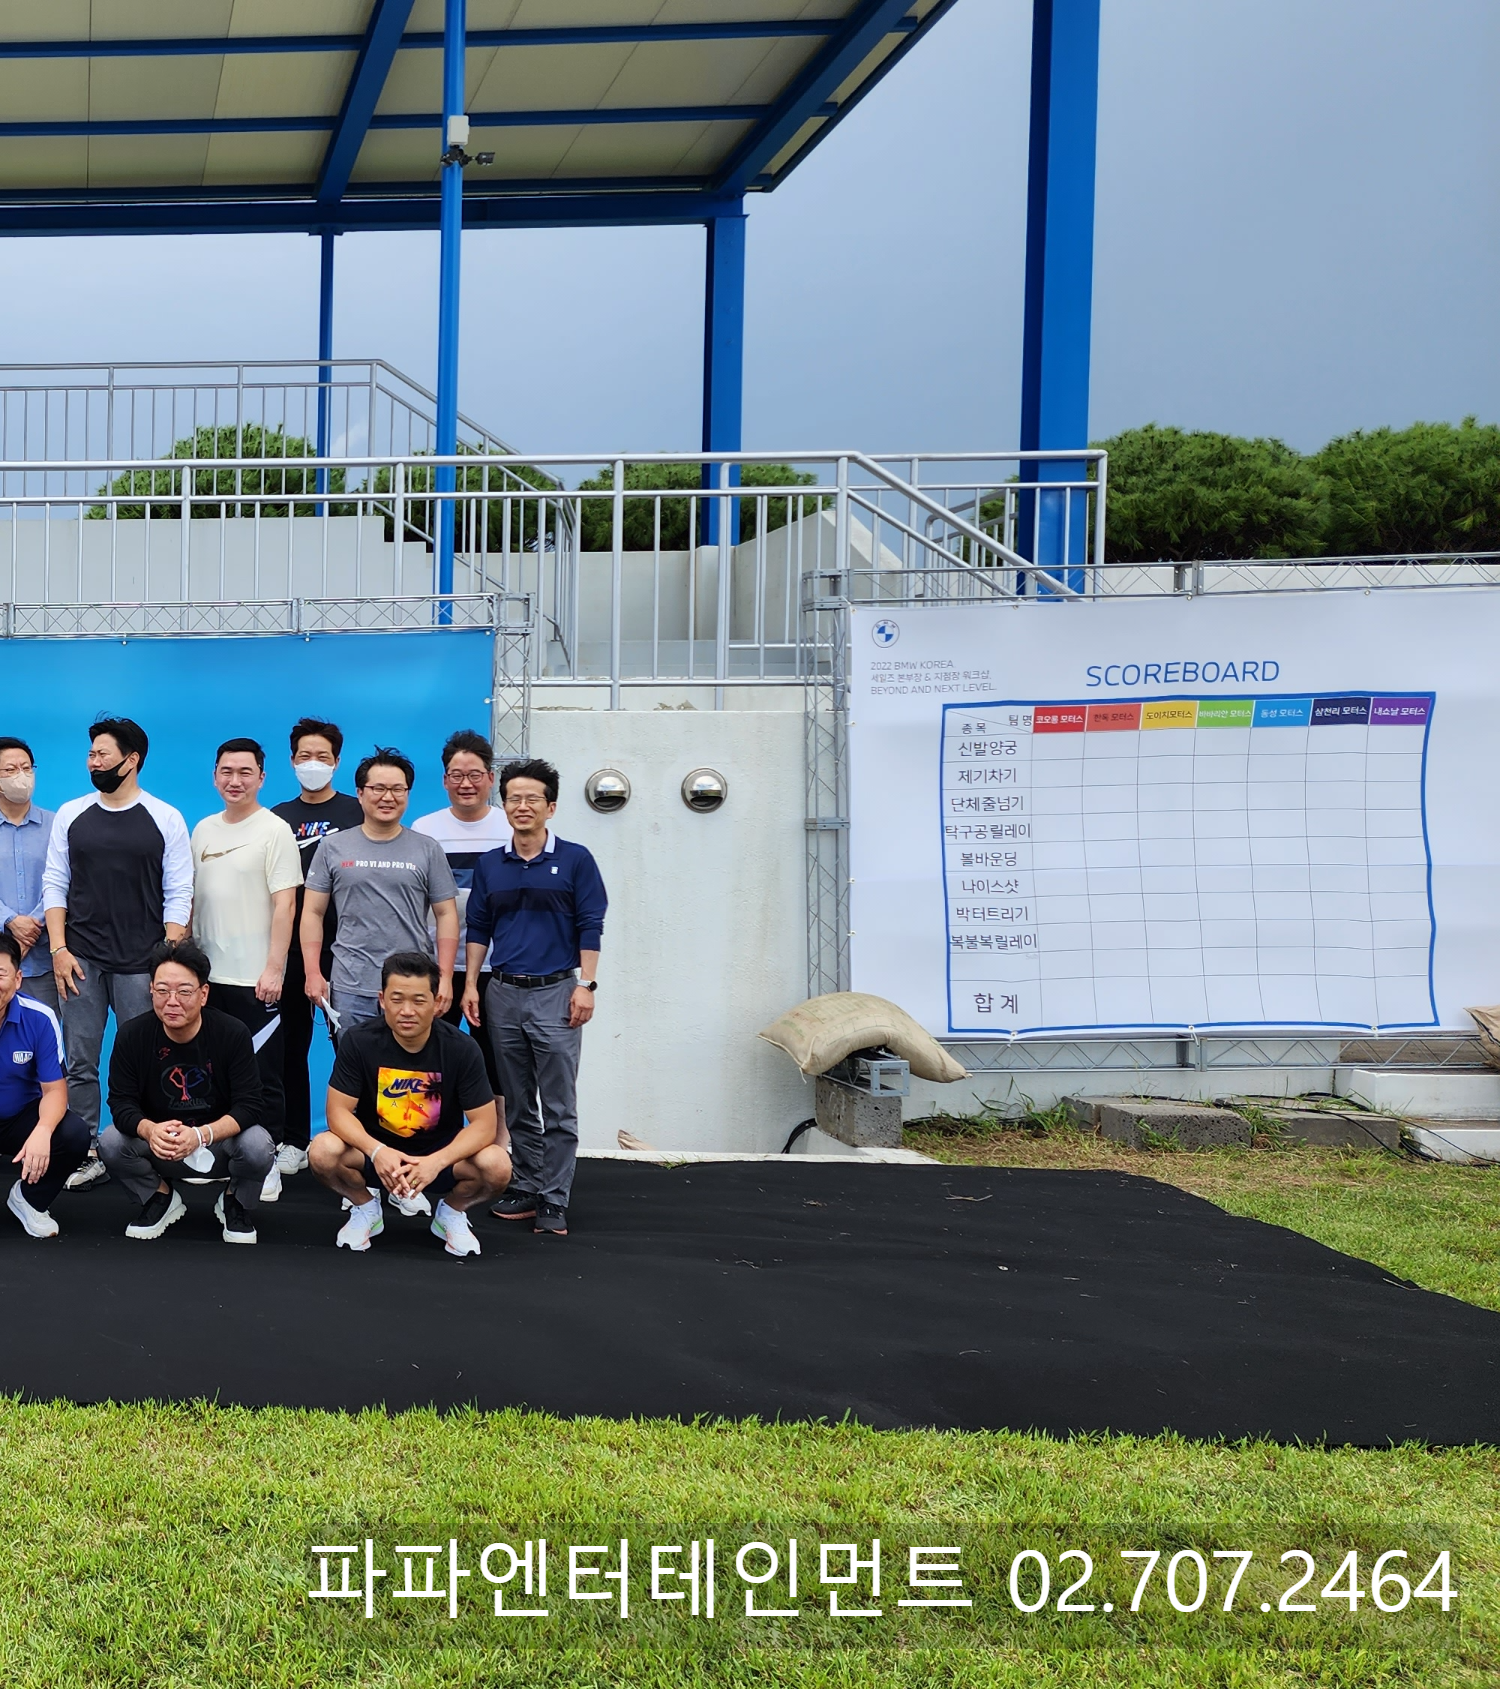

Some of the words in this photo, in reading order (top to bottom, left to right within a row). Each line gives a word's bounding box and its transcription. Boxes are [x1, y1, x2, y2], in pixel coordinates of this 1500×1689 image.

[870, 661, 892, 671] 2022
[894, 661, 918, 670] BMW
[925, 673, 932, 681] &
[934, 671, 960, 681] 지점장
[1086, 661, 1280, 687] SCOREBOARD
[870, 686, 909, 695] BEYOND
[911, 685, 932, 694] AND
[934, 684, 961, 693] NEXT
[1198, 709, 1228, 718] 바바리안
[1229, 709, 1252, 718] 모터스
[1260, 708, 1278, 718] 동성
[1278, 708, 1304, 717] 모터스
[1314, 707, 1340, 717] 삼천리
[1341, 706, 1368, 715] 모터스
[1373, 706, 1399, 717] 내쇼날
[1400, 706, 1426, 716] 모터스
[1035, 715, 1058, 725] 코오롱
[1060, 714, 1084, 724] 모터스
[1093, 713, 1110, 723] 한독
[1111, 712, 1134, 722] 모터스
[958, 767, 1017, 784] 제기차기
[355, 860, 369, 868] PRO
[377, 860, 391, 869] AND
[392, 861, 405, 869] PRO
[960, 851, 1018, 867] 볼바운딩
[961, 878, 1020, 895] 나이스샷
[390, 1077, 423, 1091] NIKE
